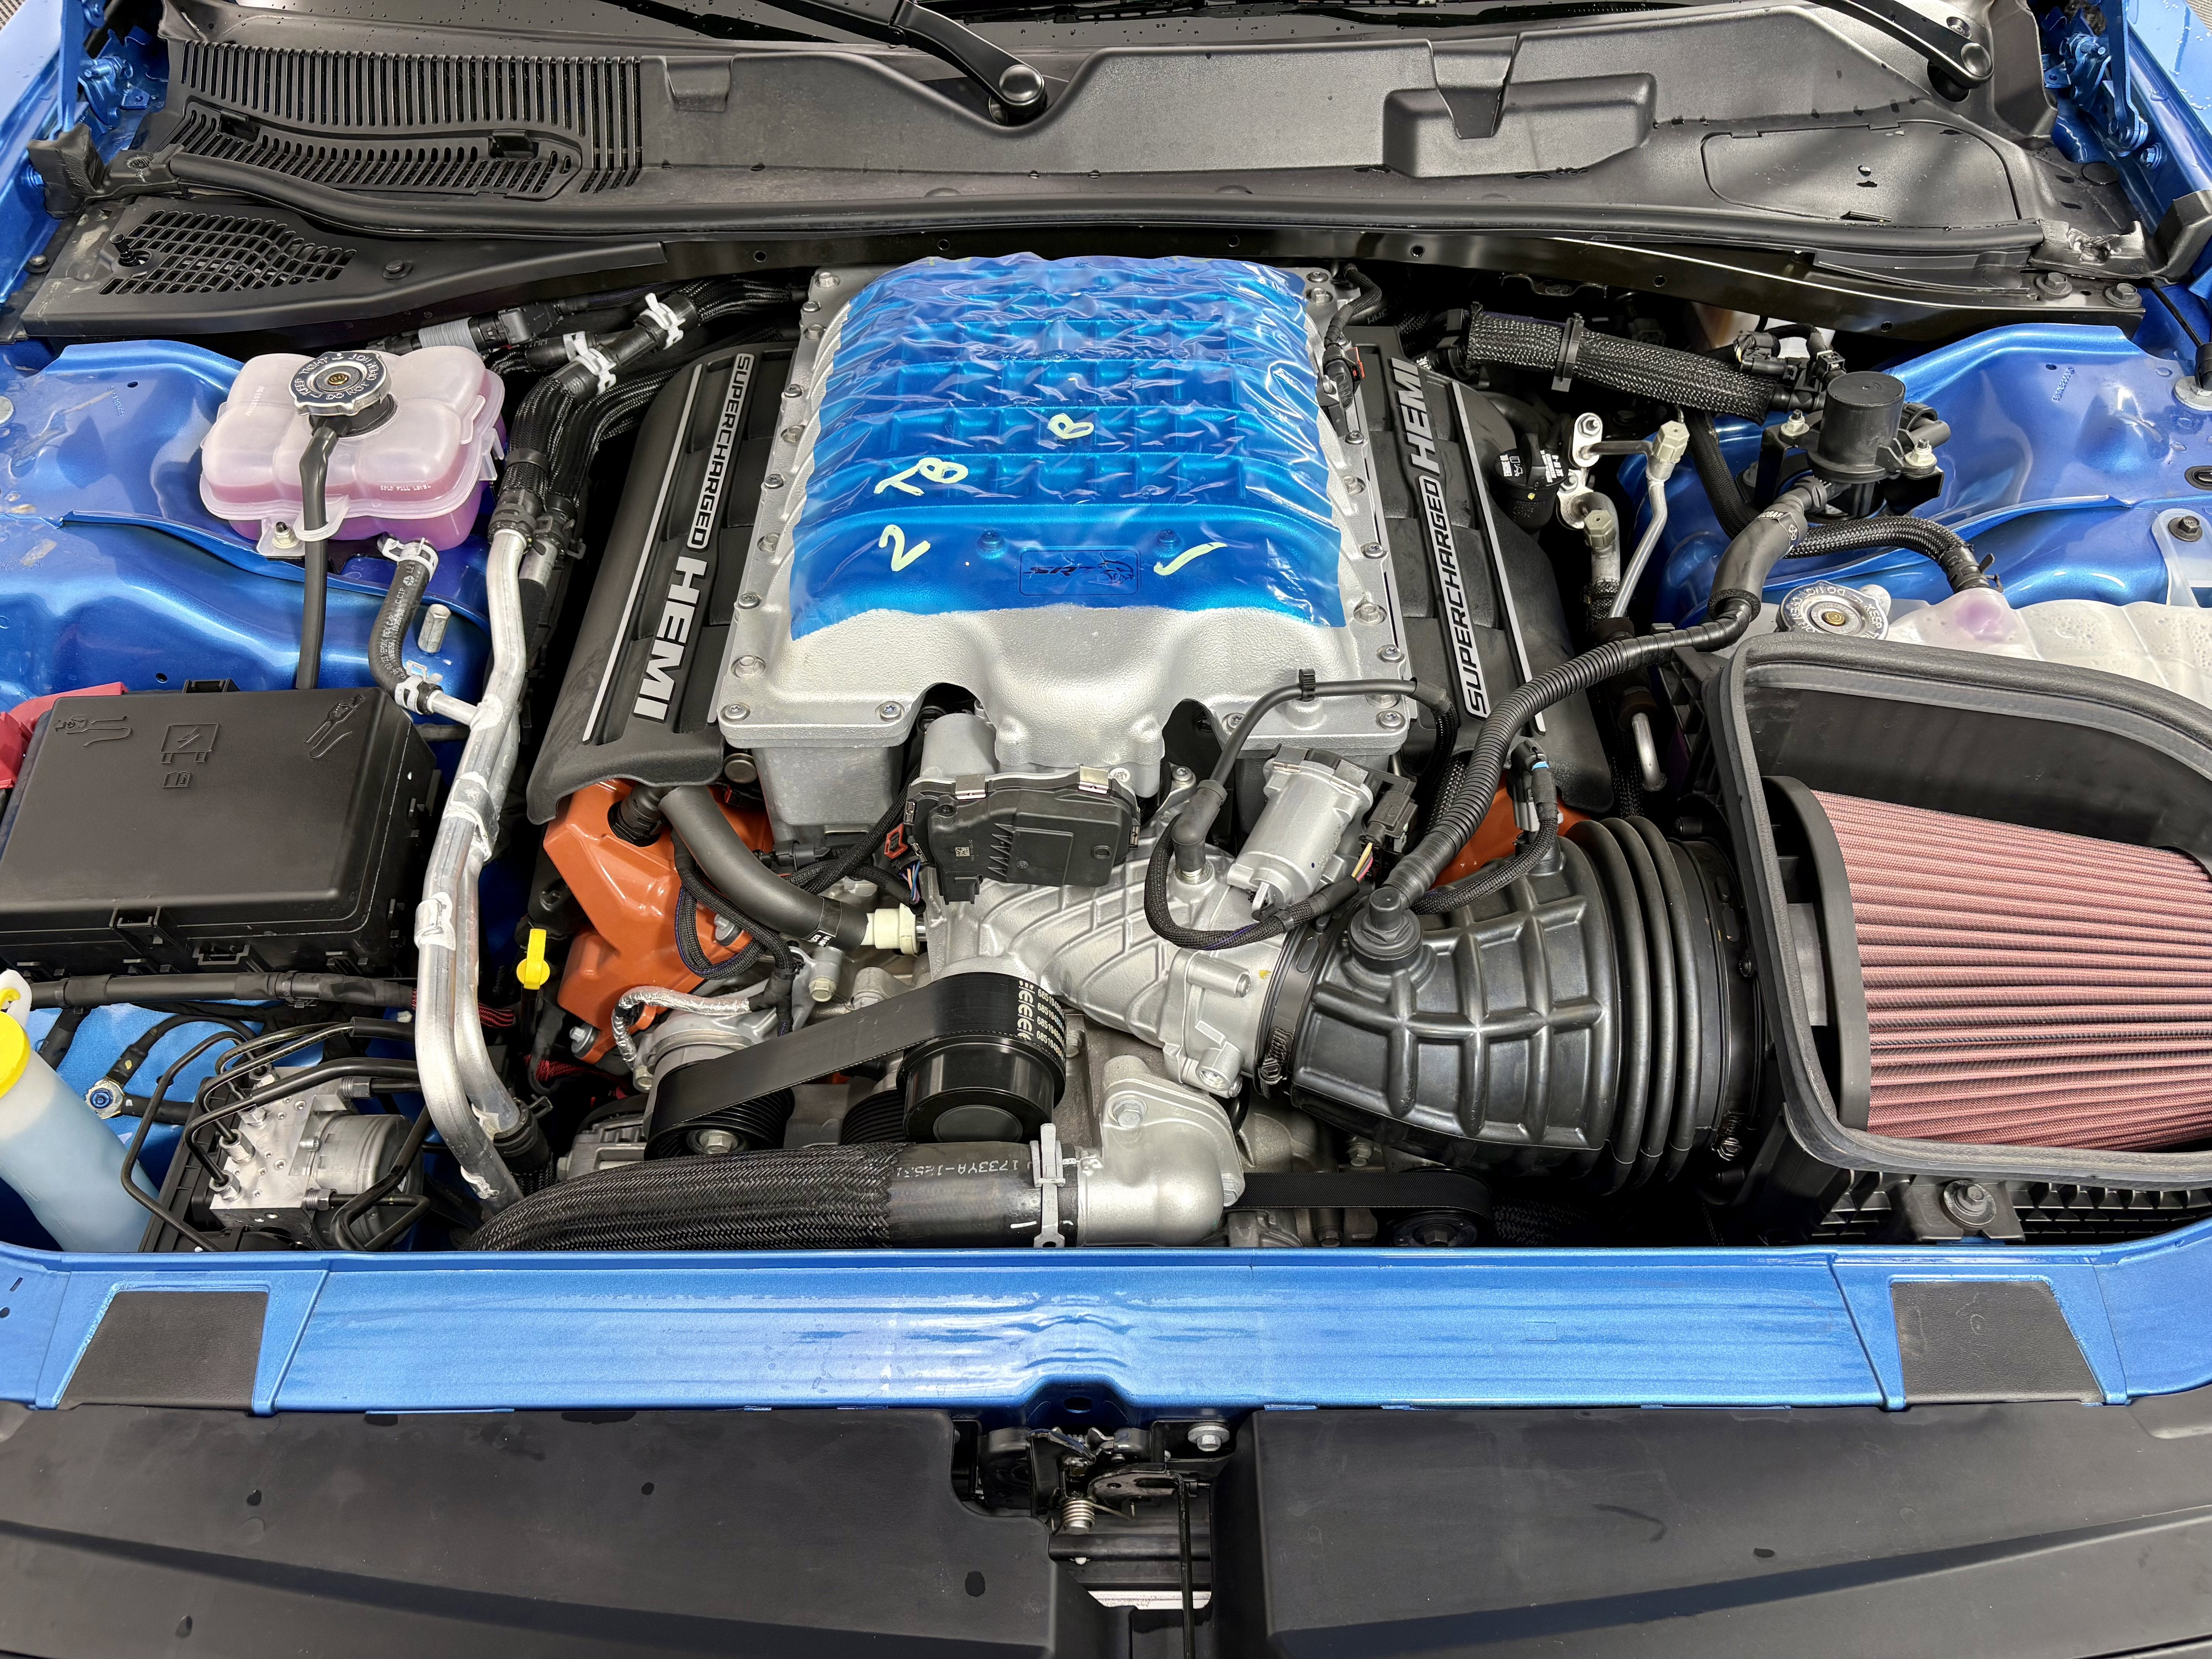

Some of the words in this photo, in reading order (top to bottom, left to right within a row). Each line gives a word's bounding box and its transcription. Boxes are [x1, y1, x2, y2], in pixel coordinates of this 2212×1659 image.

[300, 357, 328, 374] TIGHT
[366, 361, 379, 381] OPEN
[295, 378, 311, 396] KEEP
[1391, 357, 1440, 476] HEMI
[690, 354, 753, 545] SUPERCHARGED
[1501, 460, 1513, 477] ENGINE
[1555, 469, 1564, 477] SAE
[1423, 479, 1489, 715] SUPERCHARGED
[1864, 603, 1883, 629] KEEP
[634, 556, 708, 721] HEMI
